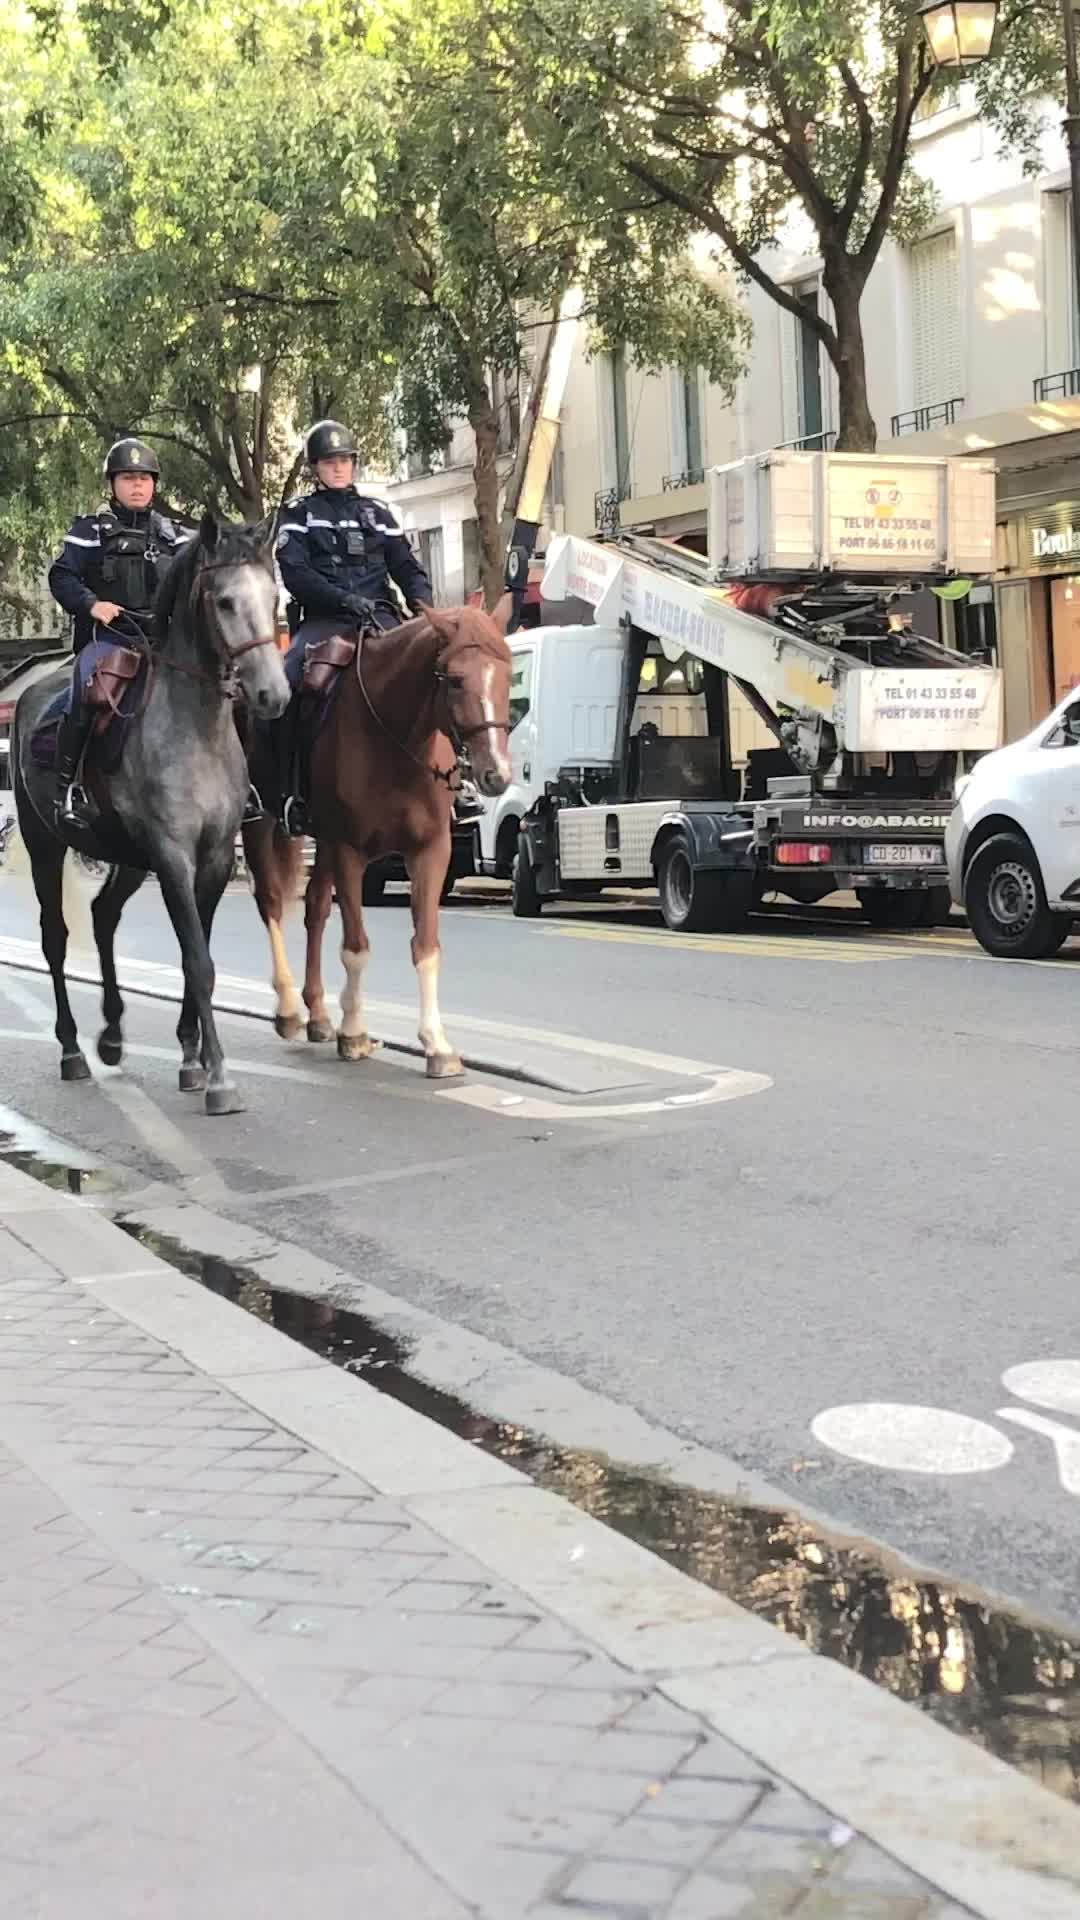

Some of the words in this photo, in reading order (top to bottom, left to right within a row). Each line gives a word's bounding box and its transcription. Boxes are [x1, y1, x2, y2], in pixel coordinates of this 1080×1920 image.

[843, 517, 861, 529] TEL
[863, 517, 875, 529] 01
[878, 518, 890, 529] 43
[892, 518, 904, 530] 33
[906, 518, 918, 530] 55
[839, 536, 865, 548] PORT
[884, 687, 903, 699] TEL
[906, 687, 918, 699] 01
[920, 687, 932, 699] 43
[935, 687, 947, 699] 33
[949, 687, 961, 699] 55
[964, 687, 977, 699] 48
[880, 707, 905, 719] PORT
[953, 707, 965, 719] 11
